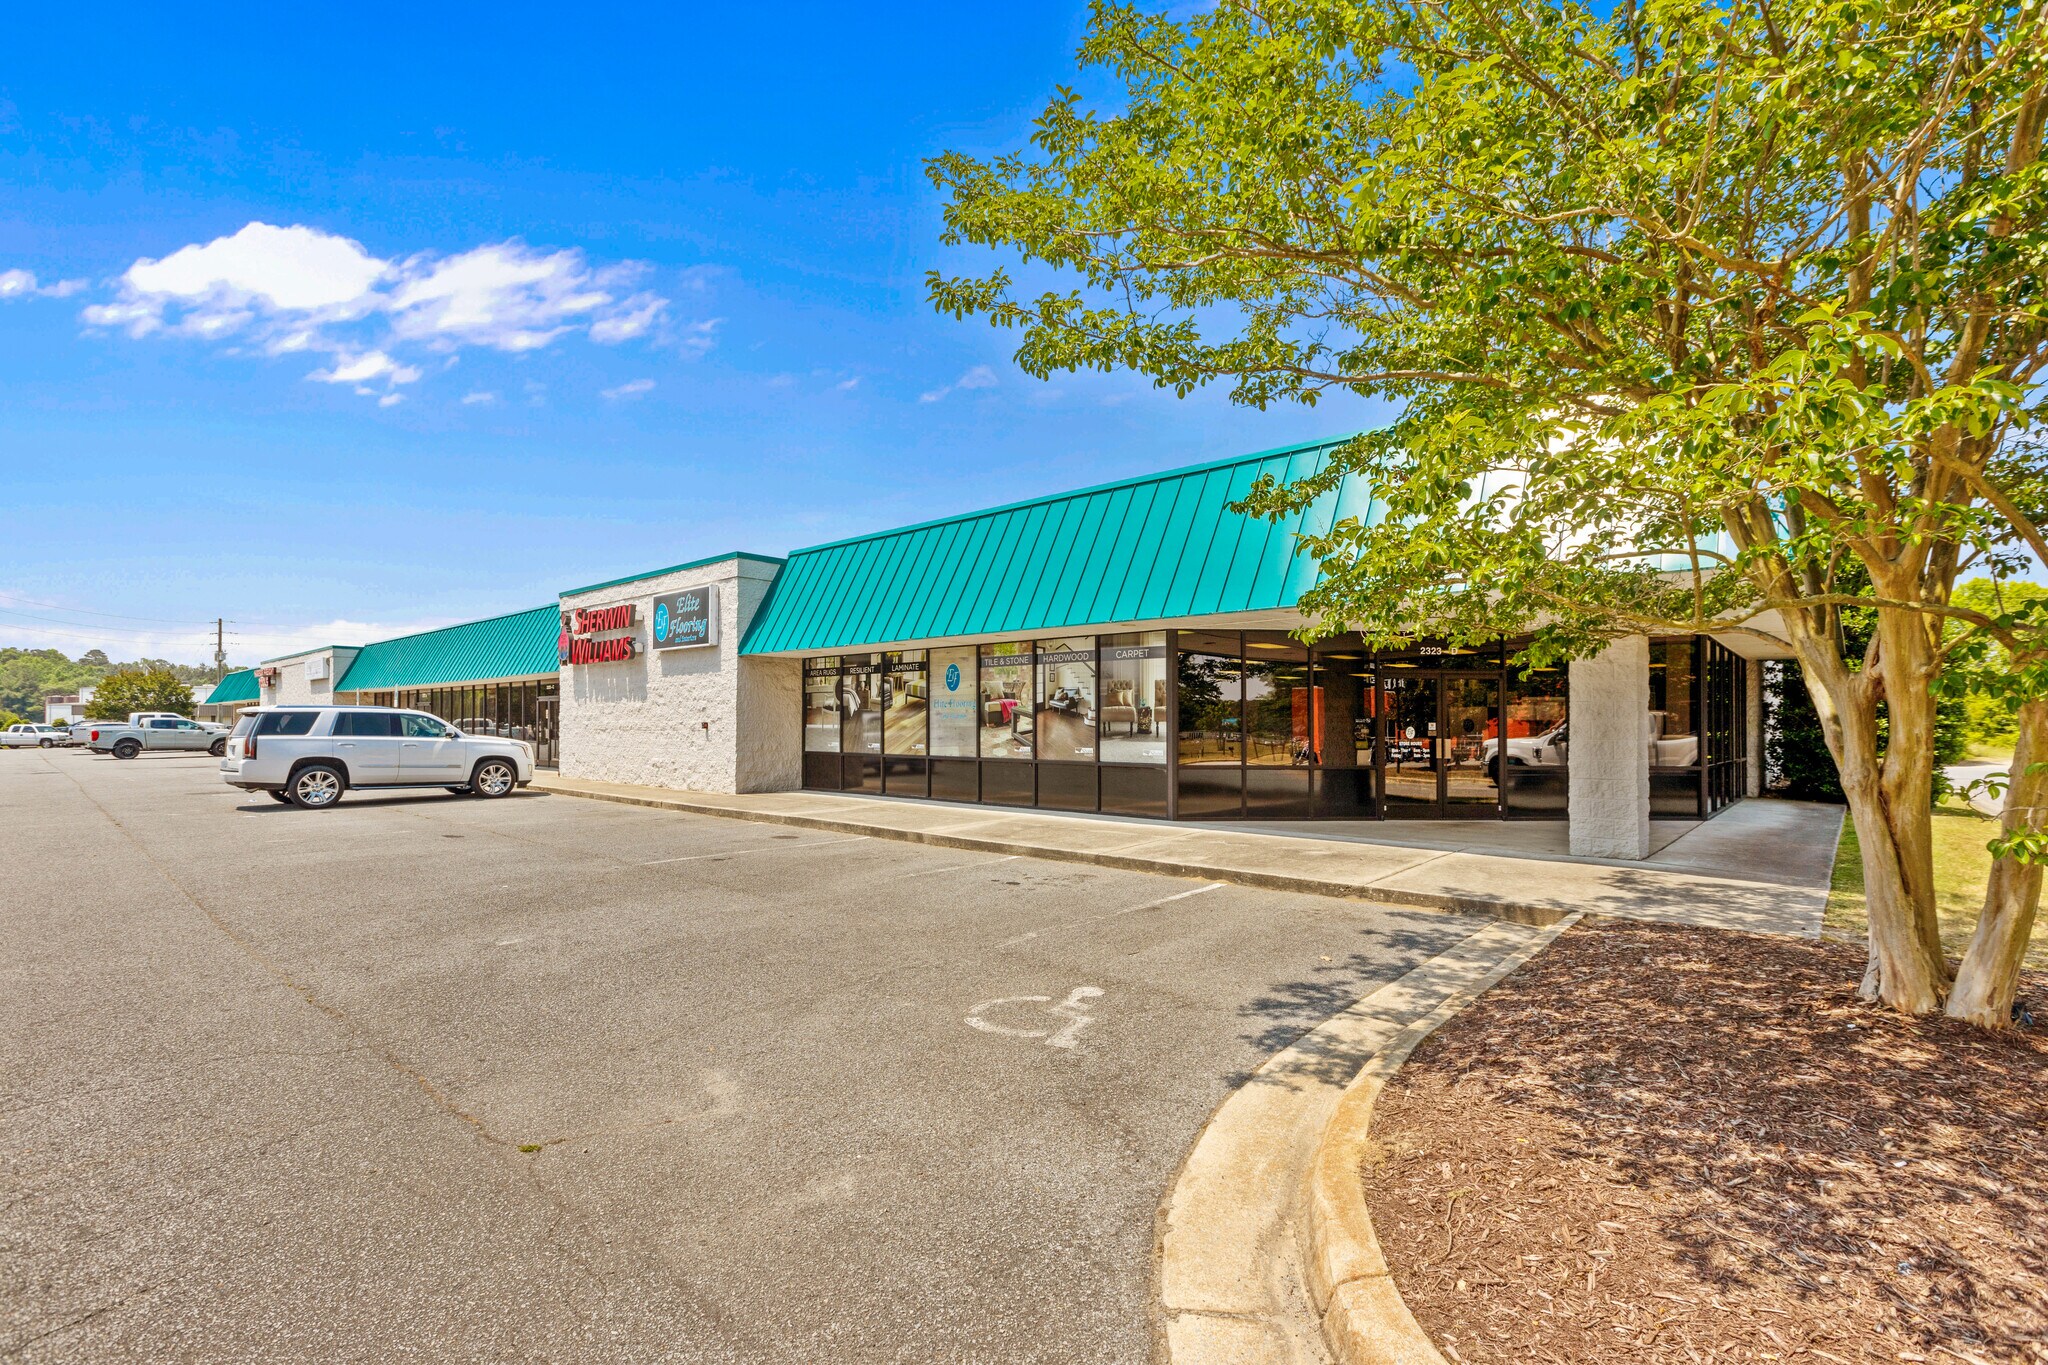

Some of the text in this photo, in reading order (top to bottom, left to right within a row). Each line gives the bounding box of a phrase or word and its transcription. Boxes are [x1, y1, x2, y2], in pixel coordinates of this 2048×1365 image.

[676, 593, 700, 614] Elite
[574, 604, 632, 635] SHERWIN
[669, 616, 707, 638] Flooring
[572, 636, 632, 665] WILLIAMS
[1116, 649, 1149, 659] CARPET
[1420, 647, 1458, 655] 2323 D
[985, 656, 1029, 666] TILE & STONE
[1043, 652, 1089, 663] HARDWOOD
[850, 666, 875, 675] RESILIENT
[891, 663, 919, 672] LAMINATE
